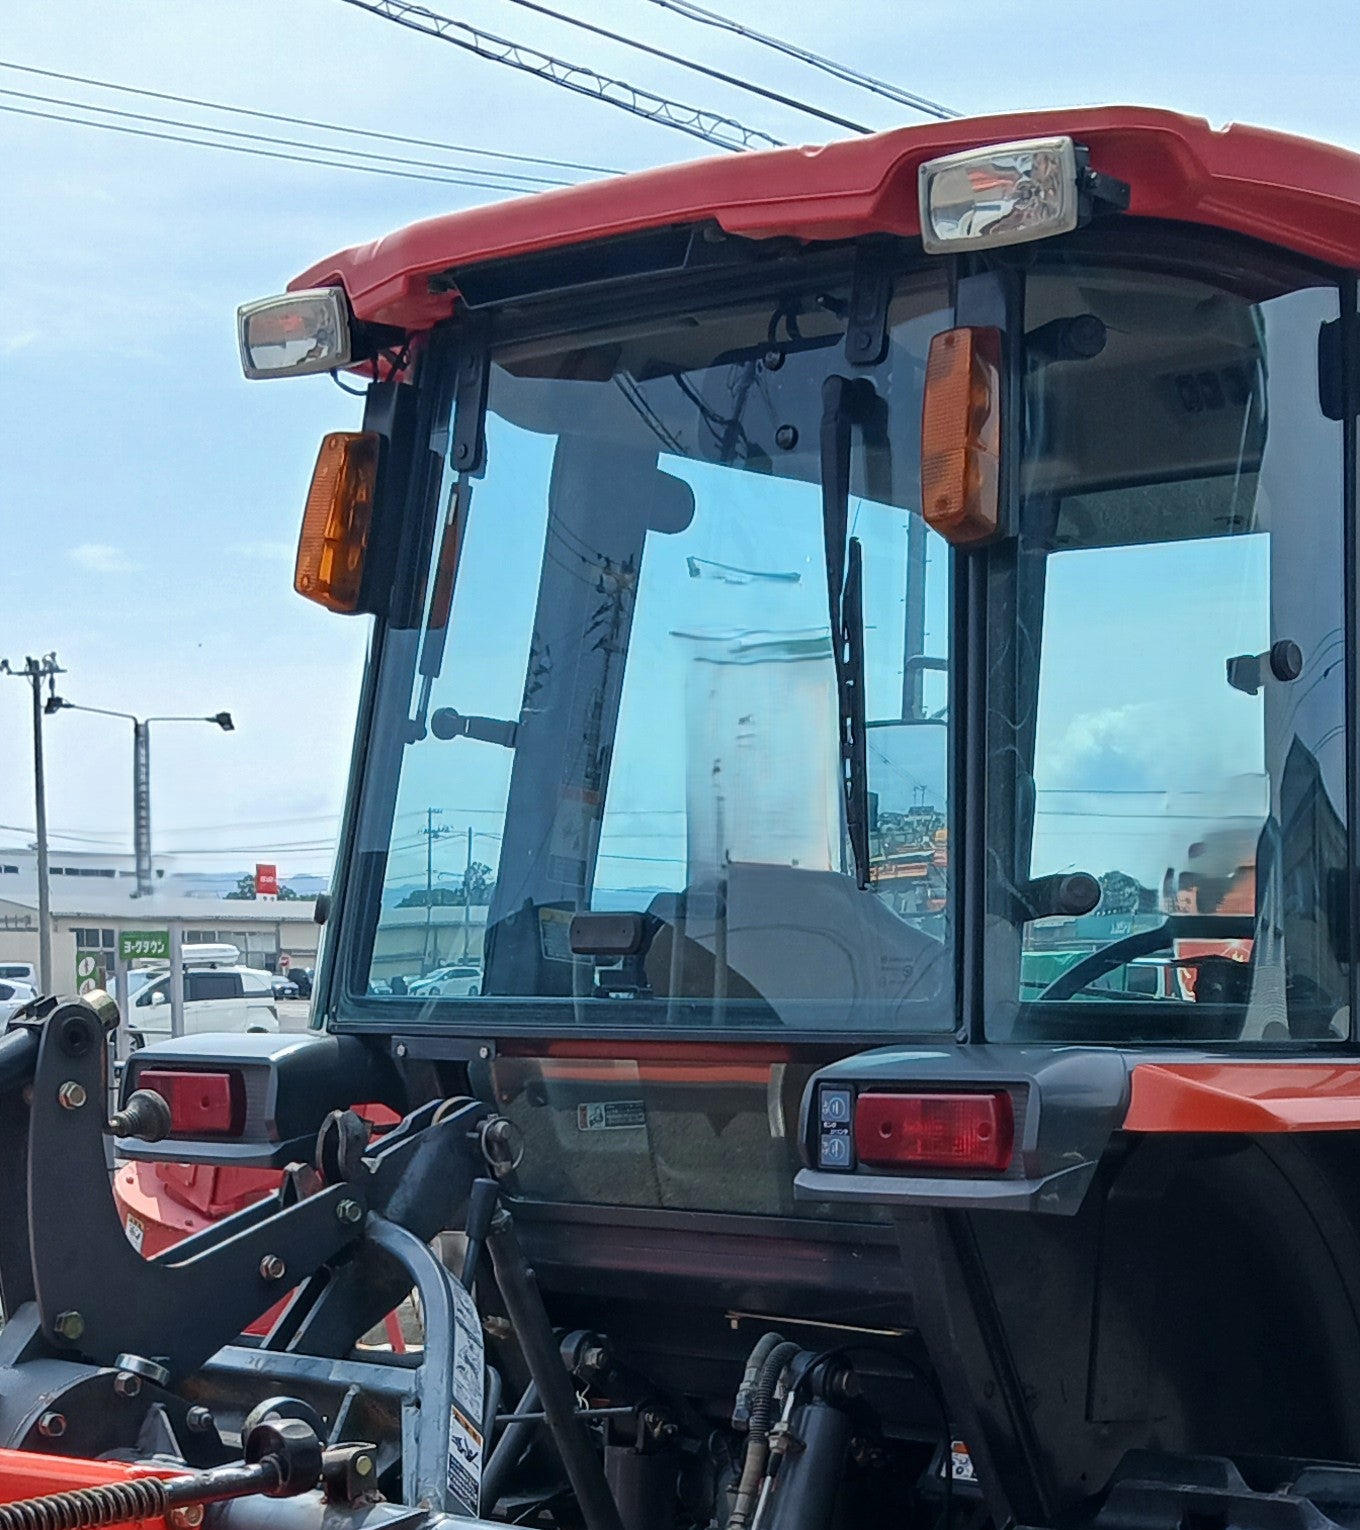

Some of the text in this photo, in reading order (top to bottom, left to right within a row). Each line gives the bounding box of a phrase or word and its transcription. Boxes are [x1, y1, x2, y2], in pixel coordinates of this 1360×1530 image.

[124, 941, 165, 954] ヨークタウン
